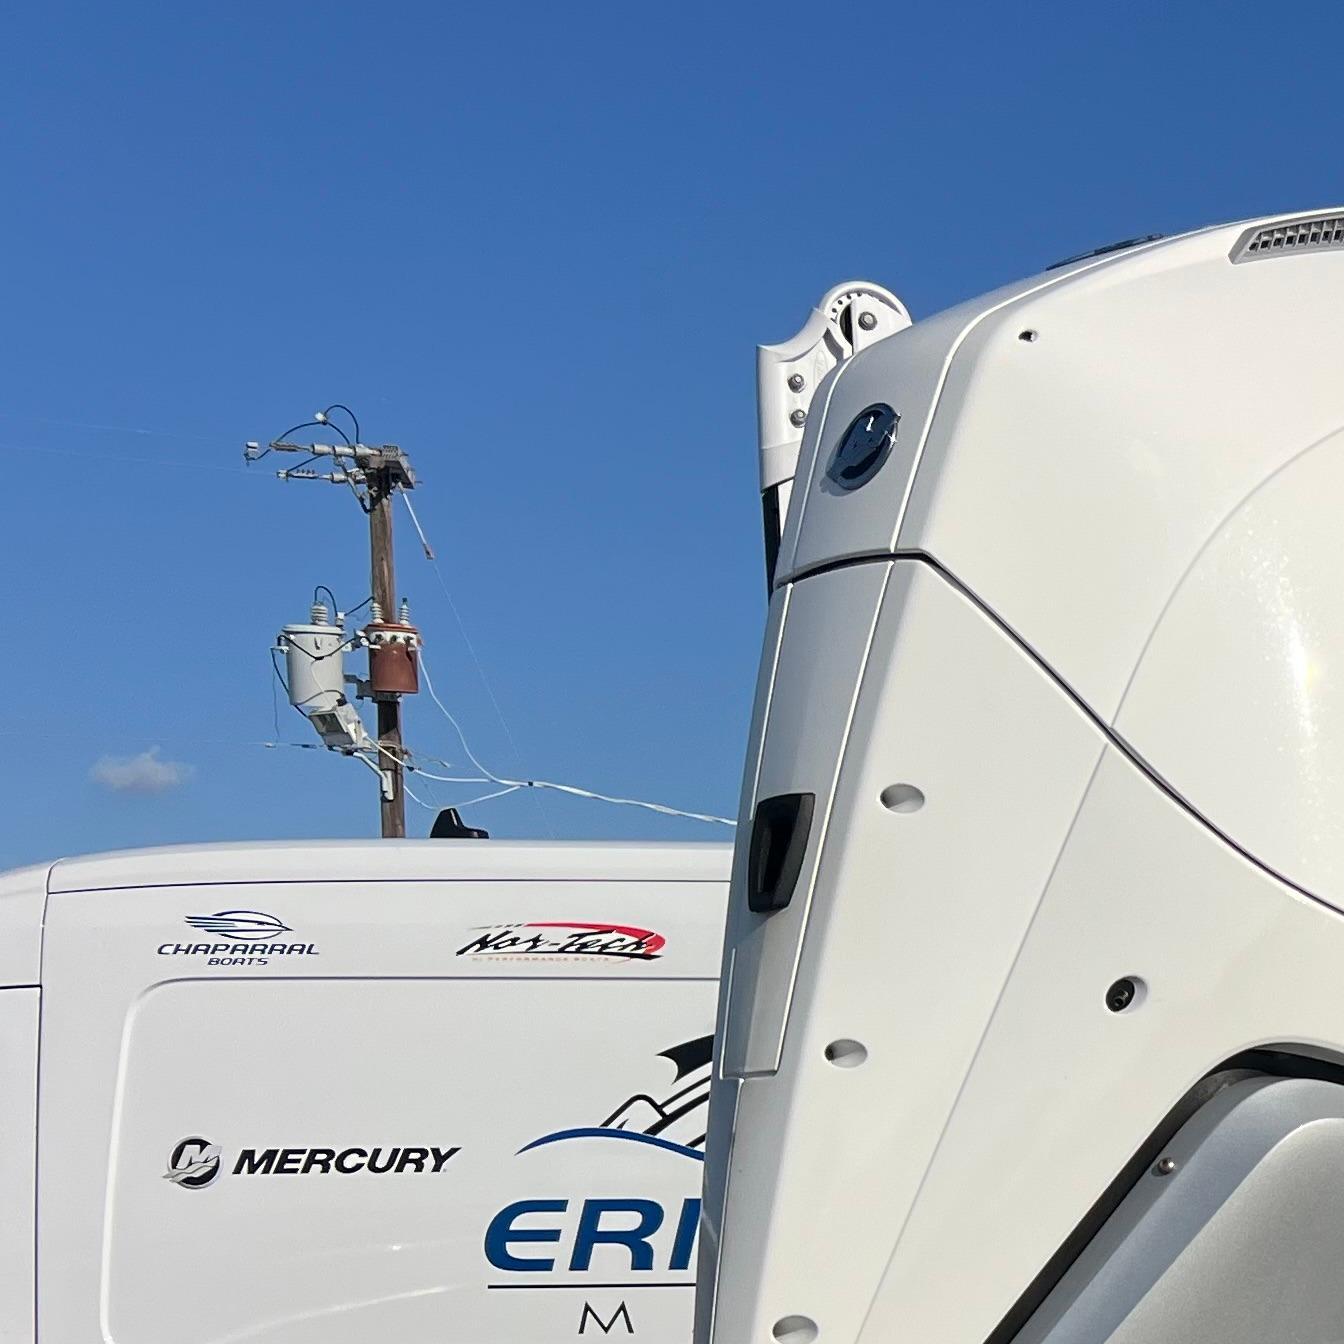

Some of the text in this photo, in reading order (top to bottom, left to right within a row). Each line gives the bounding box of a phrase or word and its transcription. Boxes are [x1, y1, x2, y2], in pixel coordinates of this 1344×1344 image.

[157, 943, 320, 955] CHAPARRAL
[207, 957, 270, 966] BOATS
[232, 1147, 462, 1174] MERCURY
[484, 1198, 701, 1272] ERI
[578, 1302, 635, 1334] M
